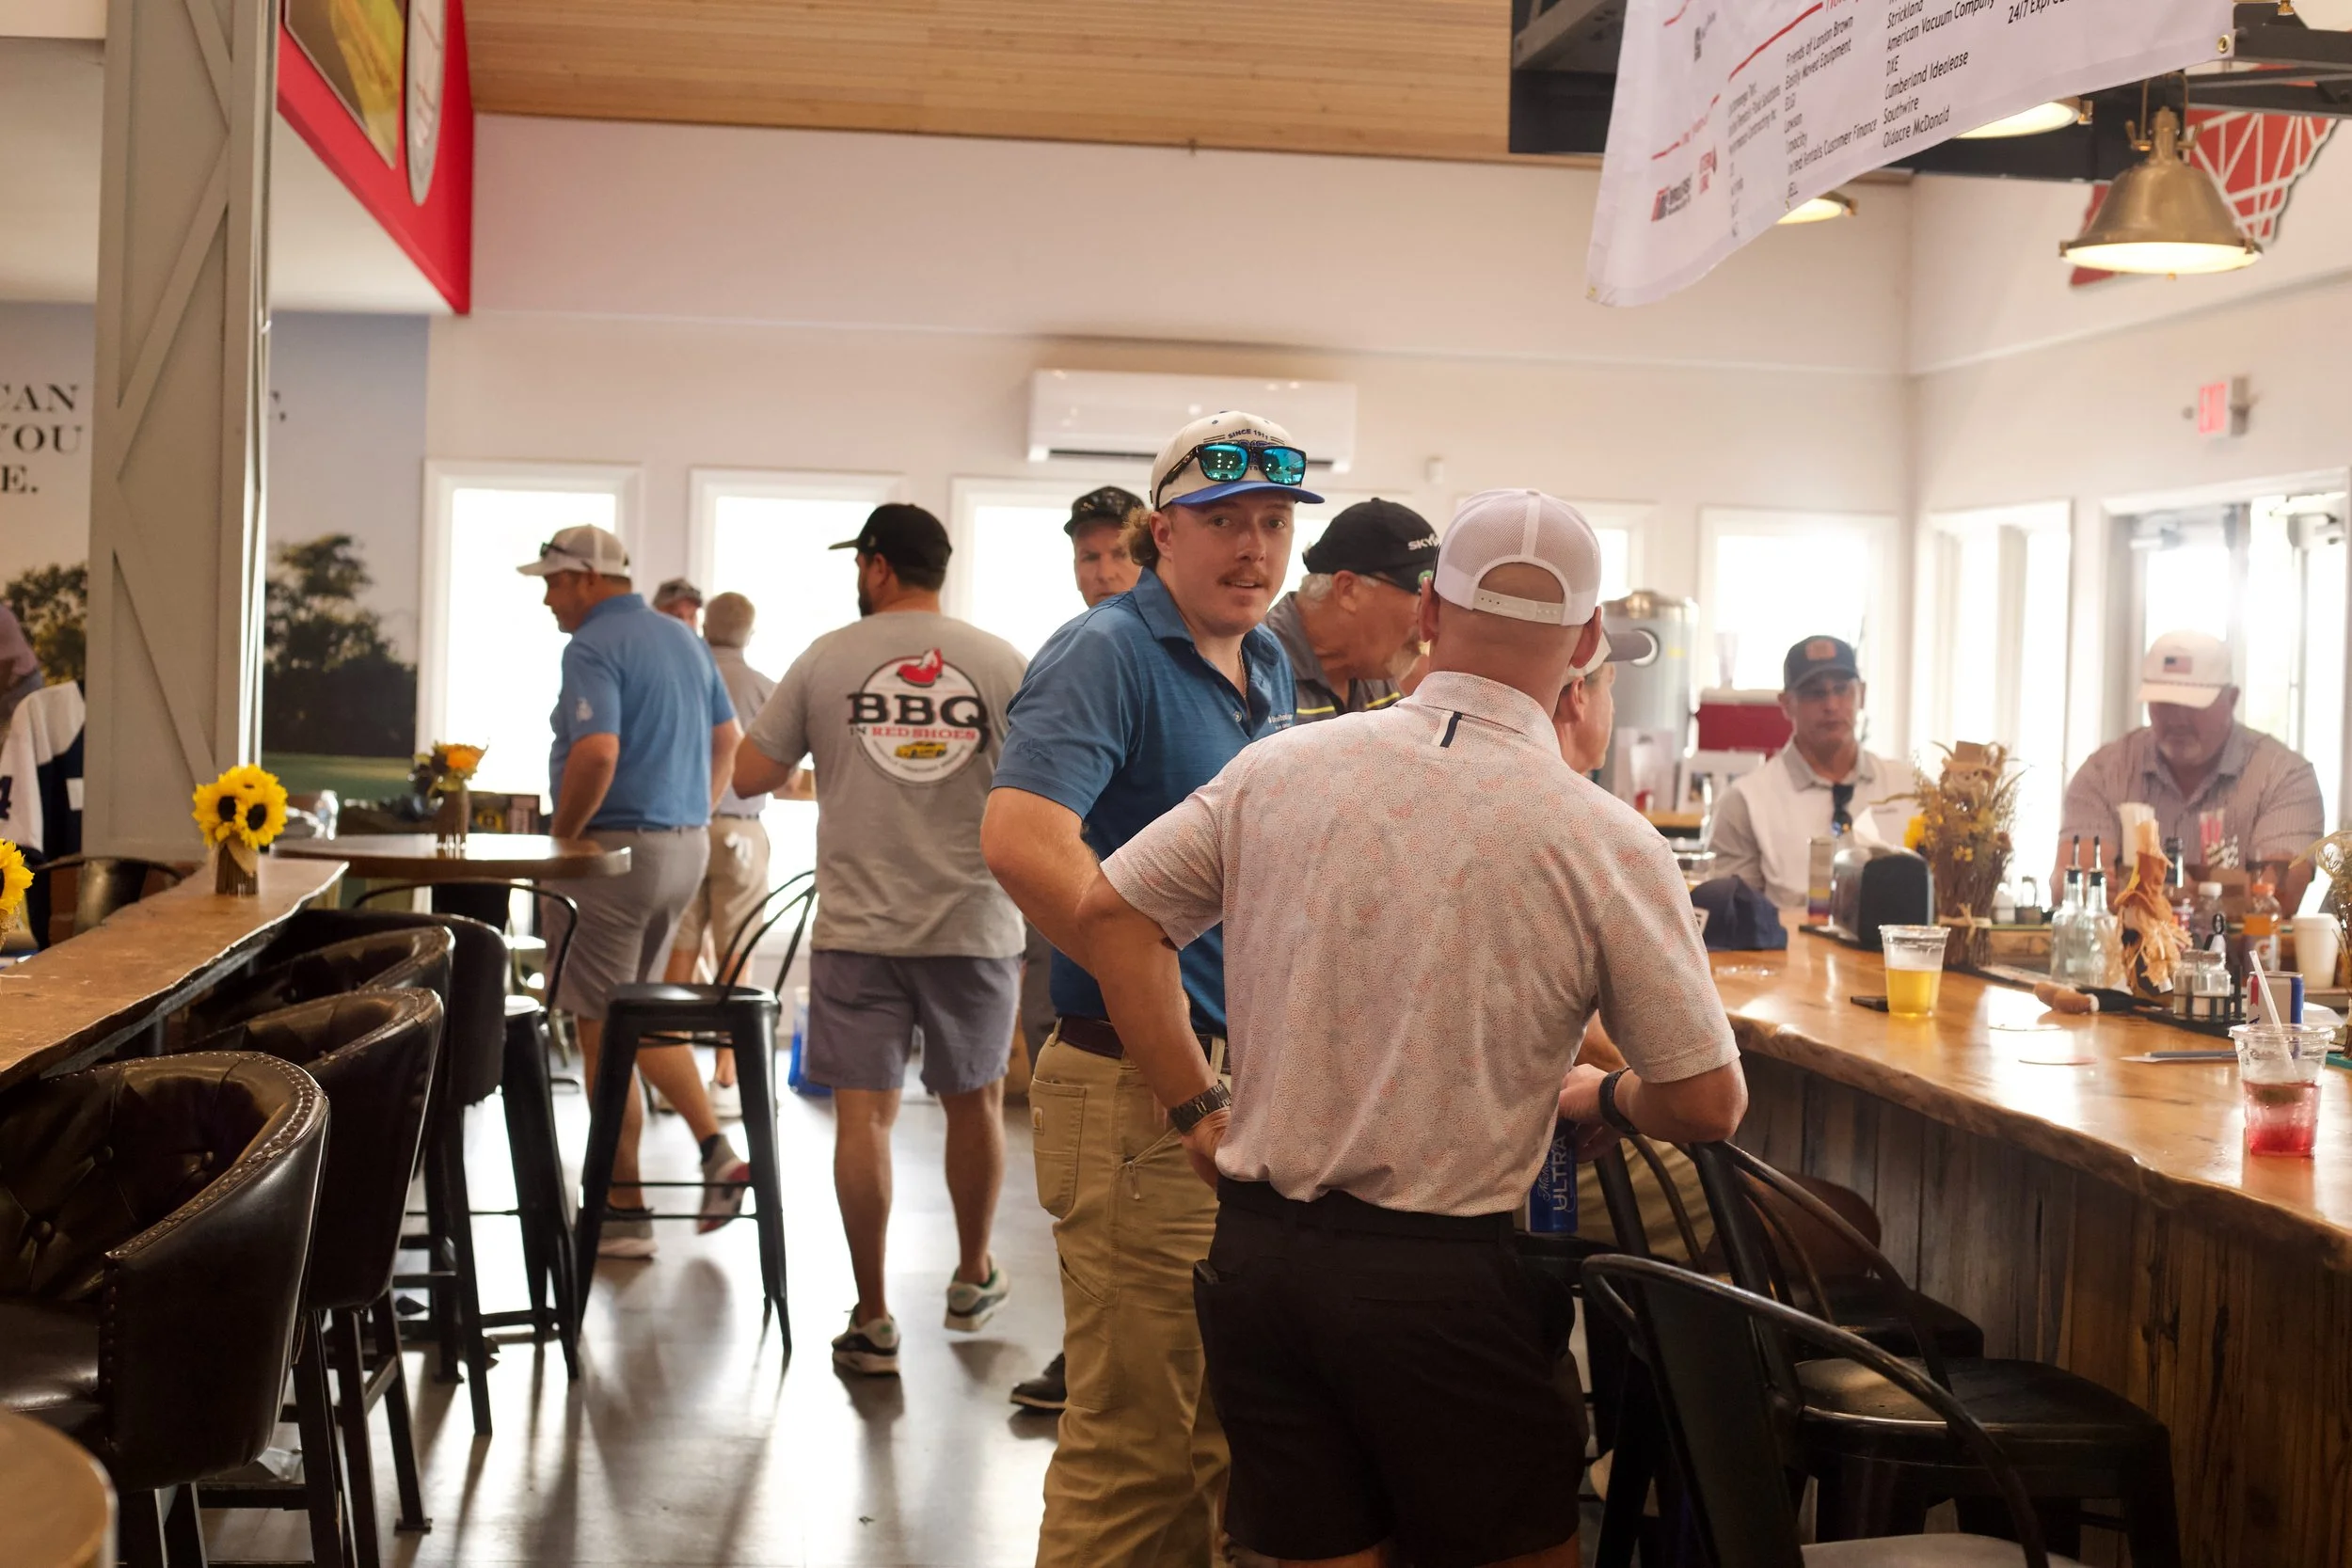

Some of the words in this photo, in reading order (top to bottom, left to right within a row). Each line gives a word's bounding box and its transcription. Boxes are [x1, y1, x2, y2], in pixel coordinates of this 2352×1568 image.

[1887, 0, 1924, 29] Strickland
[2030, 0, 2069, 14] Expr
[1786, 46, 1805, 68] Friends
[1805, 38, 1812, 57] of
[1834, 16, 1853, 37] Brown
[1886, 25, 1918, 53] American
[1921, 11, 1952, 35] Vacuum
[1954, 0, 1994, 19] Company
[1820, 38, 1851, 68] Equipment
[1886, 55, 1899, 77] DXE
[1884, 63, 1928, 100] Cumberland
[1930, 52, 1969, 81] Idealease
[1883, 95, 1918, 124] Southwire
[1883, 119, 1910, 148] Oldacre
[1913, 103, 1950, 134] McDonald
[1824, 131, 1851, 156] Customer
[1853, 119, 1878, 141] Finance
[1228, 429, 1251, 439] SINCE
[1253, 430, 1268, 439] 1911
[847, 692, 990, 753] BBQ
[871, 726, 910, 737] RED
[912, 727, 976, 741] SHOES
[1552, 1136, 1567, 1212] ULTRA
